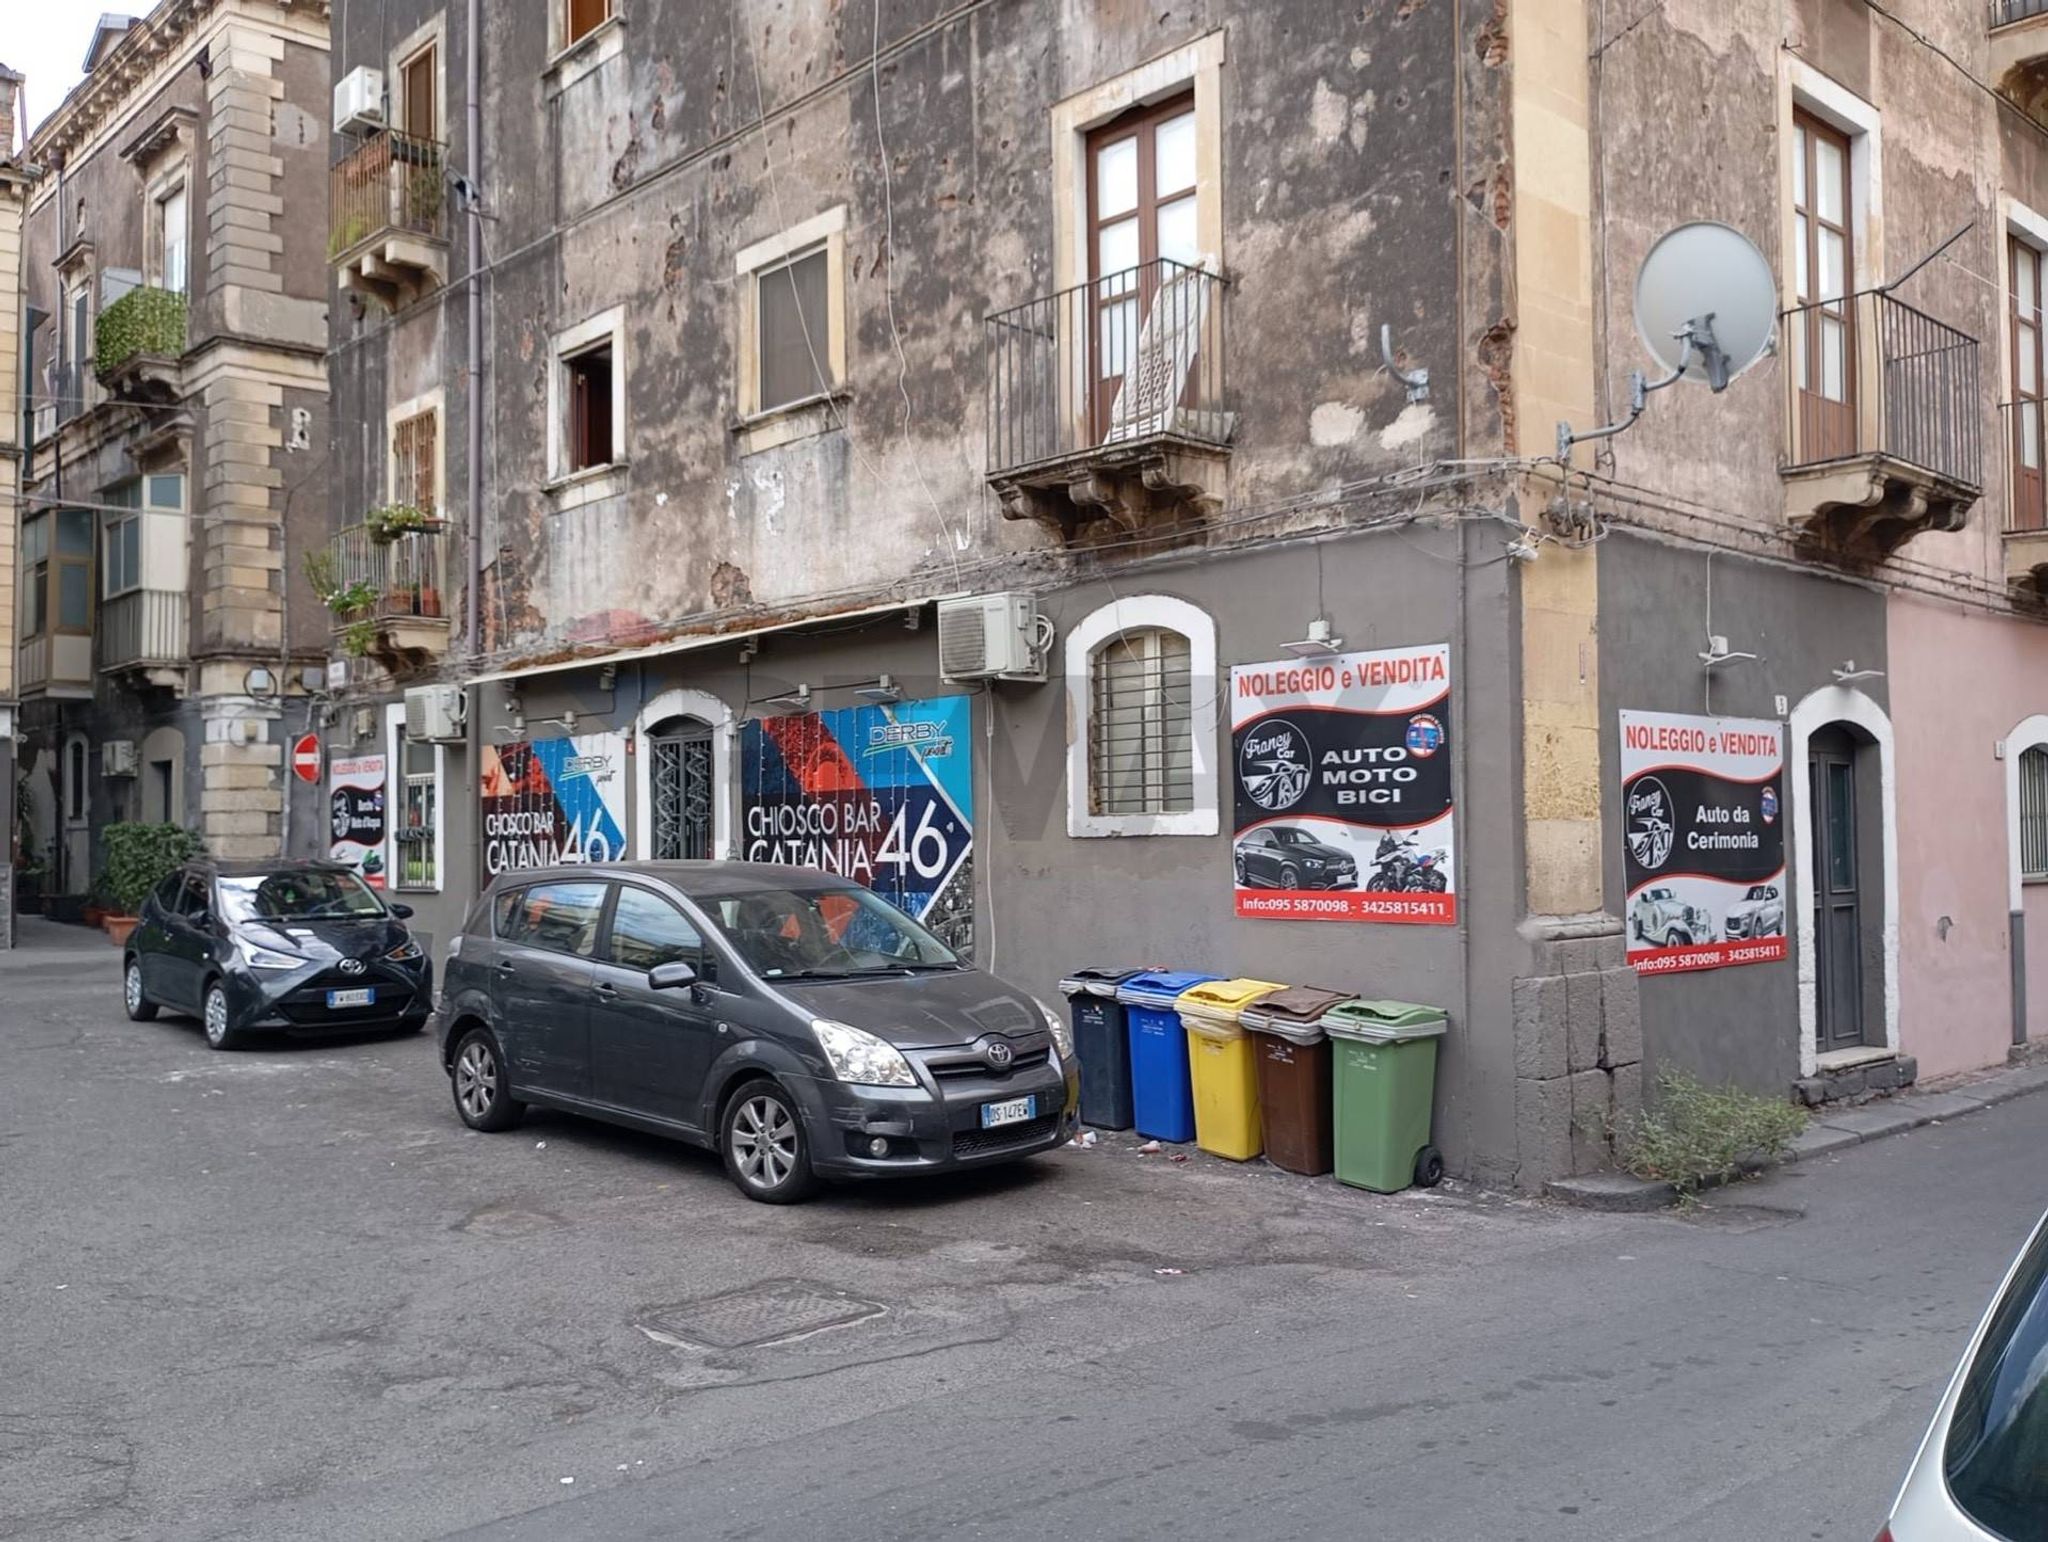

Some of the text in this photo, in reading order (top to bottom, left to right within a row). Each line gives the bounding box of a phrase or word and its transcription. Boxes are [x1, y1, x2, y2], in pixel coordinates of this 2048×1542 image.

[1238, 656, 1445, 698] NOLEGGIO e VENDITA
[869, 720, 947, 744] DERBY
[1626, 725, 1777, 757] NOLEGGIO e VENDITA
[1245, 731, 1292, 760] Francy
[1277, 748, 1295, 760] Car
[1321, 746, 1408, 765] AUTO
[1322, 766, 1417, 784] MOTO
[1337, 789, 1401, 804] BICI
[486, 811, 555, 836] CHIOSCO BAR
[748, 801, 881, 837] CHIOSCO BAR
[1696, 805, 1750, 823] Auto da
[560, 808, 611, 865] 46
[875, 799, 948, 879] 46
[1687, 831, 1760, 849] Cerimonia
[487, 839, 560, 875] CATANIA
[1294, 899, 1348, 912] 5870098
[1361, 901, 1445, 915] 3425815411
[1728, 945, 1780, 962] 3425815411
